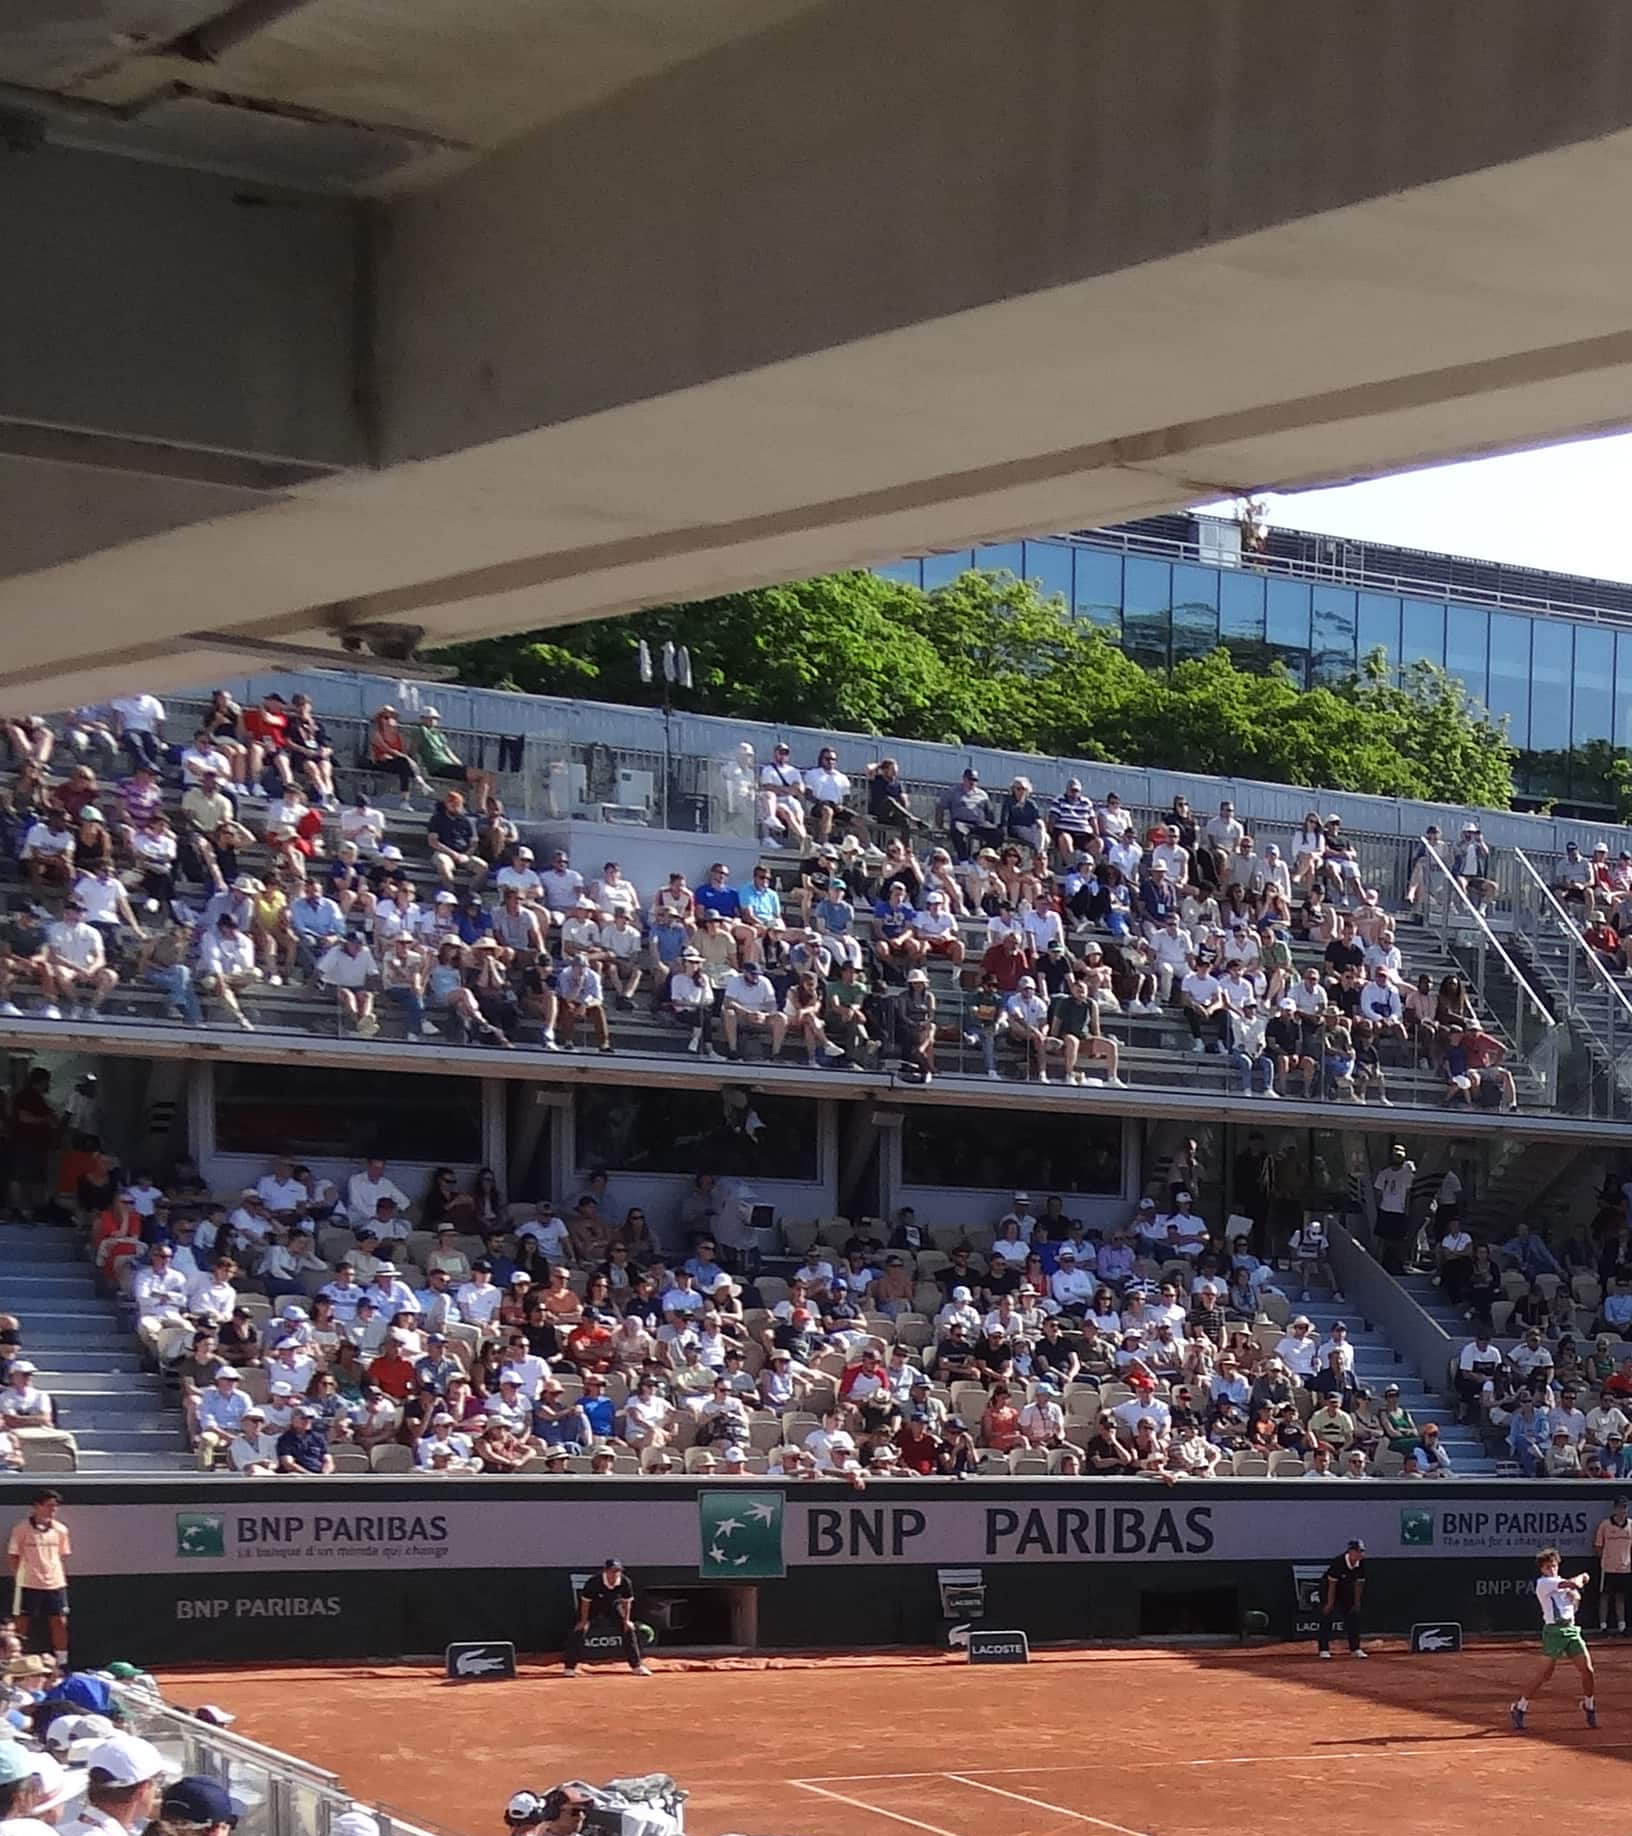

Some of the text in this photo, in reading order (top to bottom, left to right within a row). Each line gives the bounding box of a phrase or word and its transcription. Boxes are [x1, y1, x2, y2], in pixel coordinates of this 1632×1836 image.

[236, 1515, 448, 1542] BNP PARIBAS
[806, 1505, 1215, 1557] BNP PARIBAS
[1442, 1511, 1588, 1534] BNP PARIBAS
[1475, 1579, 1511, 1596] BNP
[175, 1596, 342, 1619] BNP PARIBAS
[971, 1644, 1023, 1655] LACOSTE
